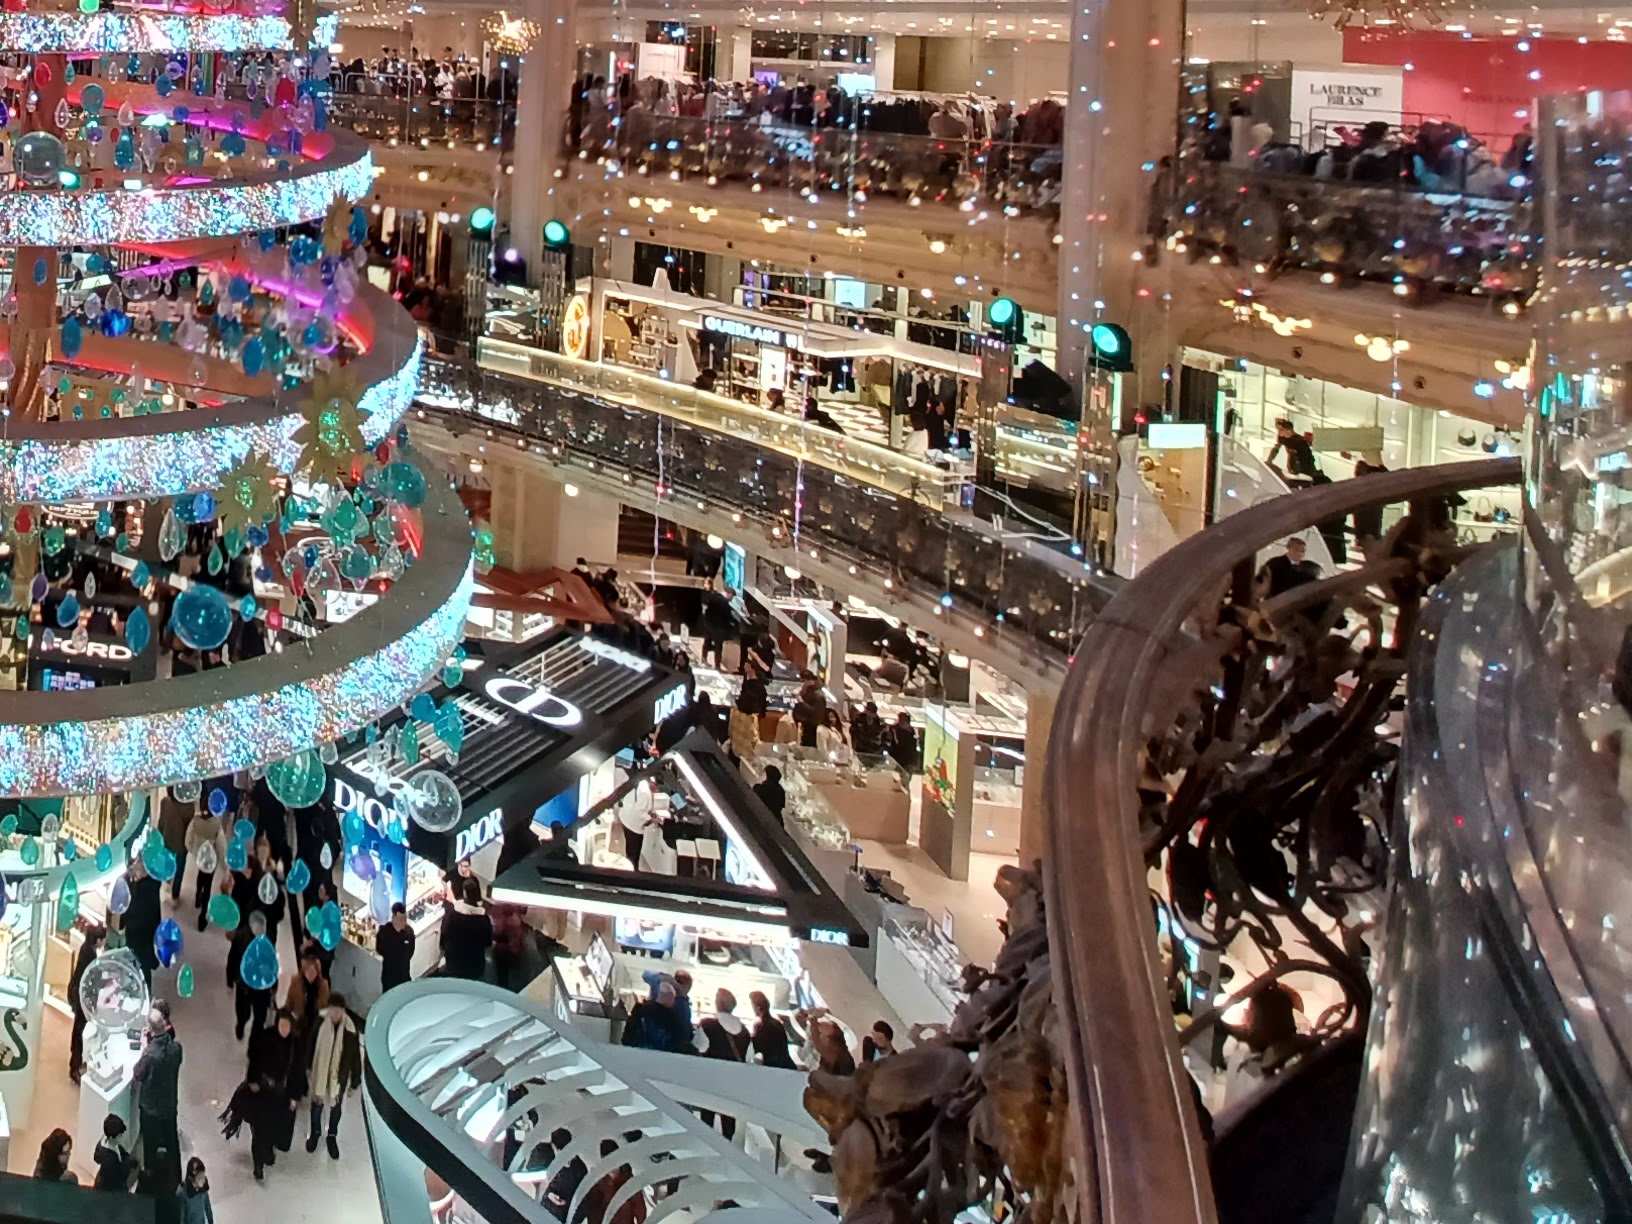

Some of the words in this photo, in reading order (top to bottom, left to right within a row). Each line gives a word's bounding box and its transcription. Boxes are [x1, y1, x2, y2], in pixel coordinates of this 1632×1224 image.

[1309, 83, 1383, 98] LAURENCE
[704, 316, 780, 345] GUERLAIN
[41, 636, 133, 660] FORD
[654, 684, 688, 725] DIOR
[455, 808, 504, 863] DIOR
[810, 927, 850, 947] DIOR
